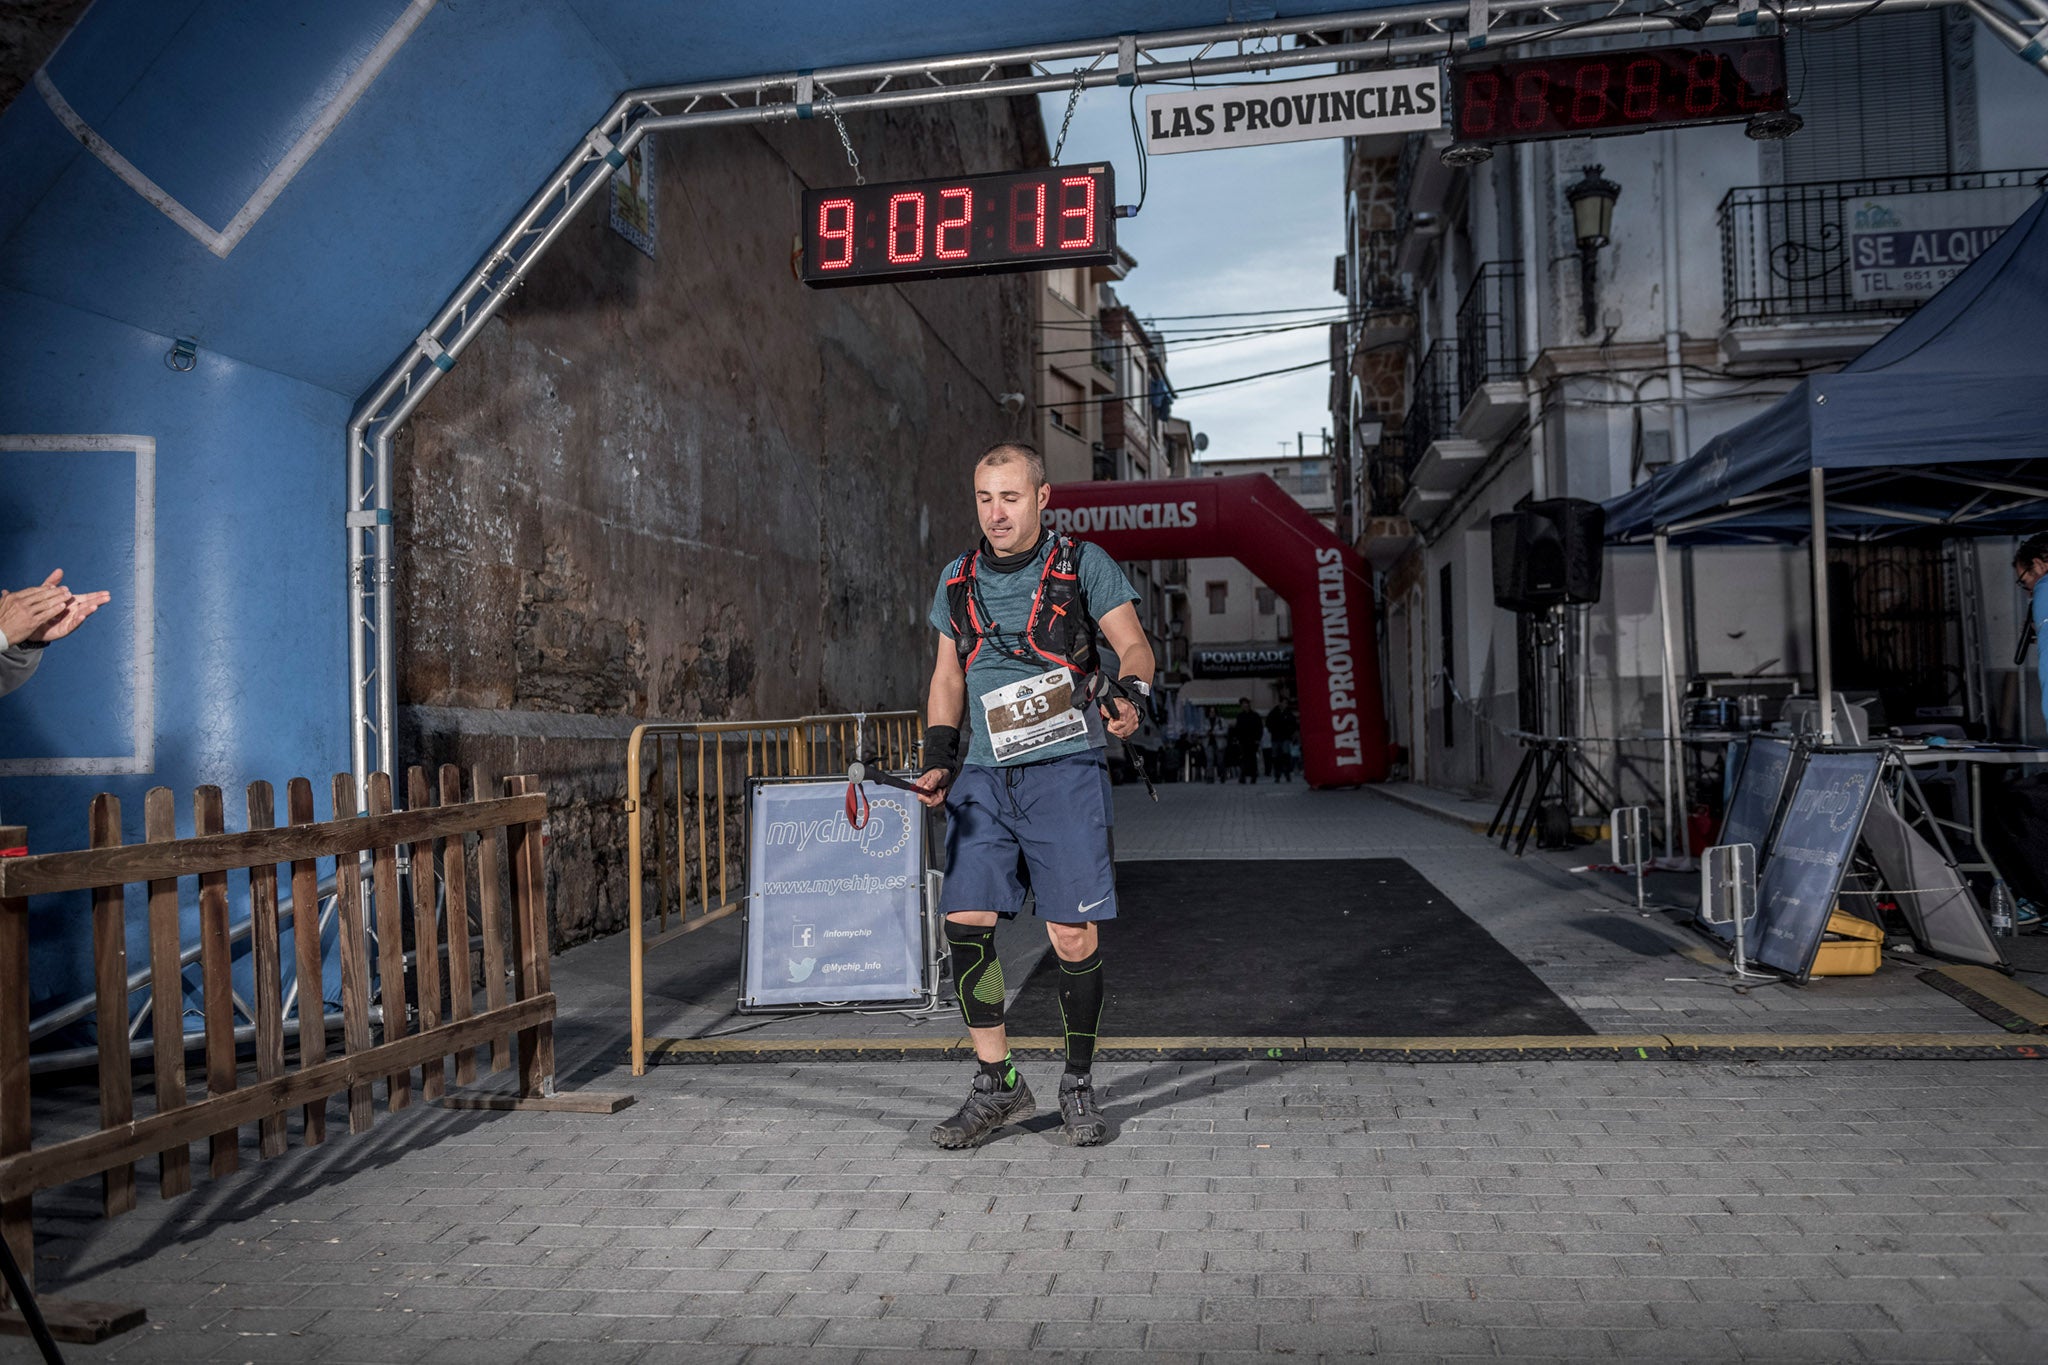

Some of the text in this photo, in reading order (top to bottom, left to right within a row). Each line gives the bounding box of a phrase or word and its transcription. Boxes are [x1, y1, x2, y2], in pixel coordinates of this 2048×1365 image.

[1151, 104, 1215, 140] LAS
[1222, 82, 1436, 133] PROVINCIAS
[1857, 235, 1896, 267] SE
[1861, 272, 1894, 293] TEL
[1040, 501, 1198, 534] PROVINCIAS
[1201, 650, 1290, 663] POWERADE
[1315, 547, 1363, 767] LAS PROVINCIAS
[1009, 695, 1050, 722] 143
[766, 810, 885, 852] mychip
[764, 873, 908, 897] www.mychip.es
